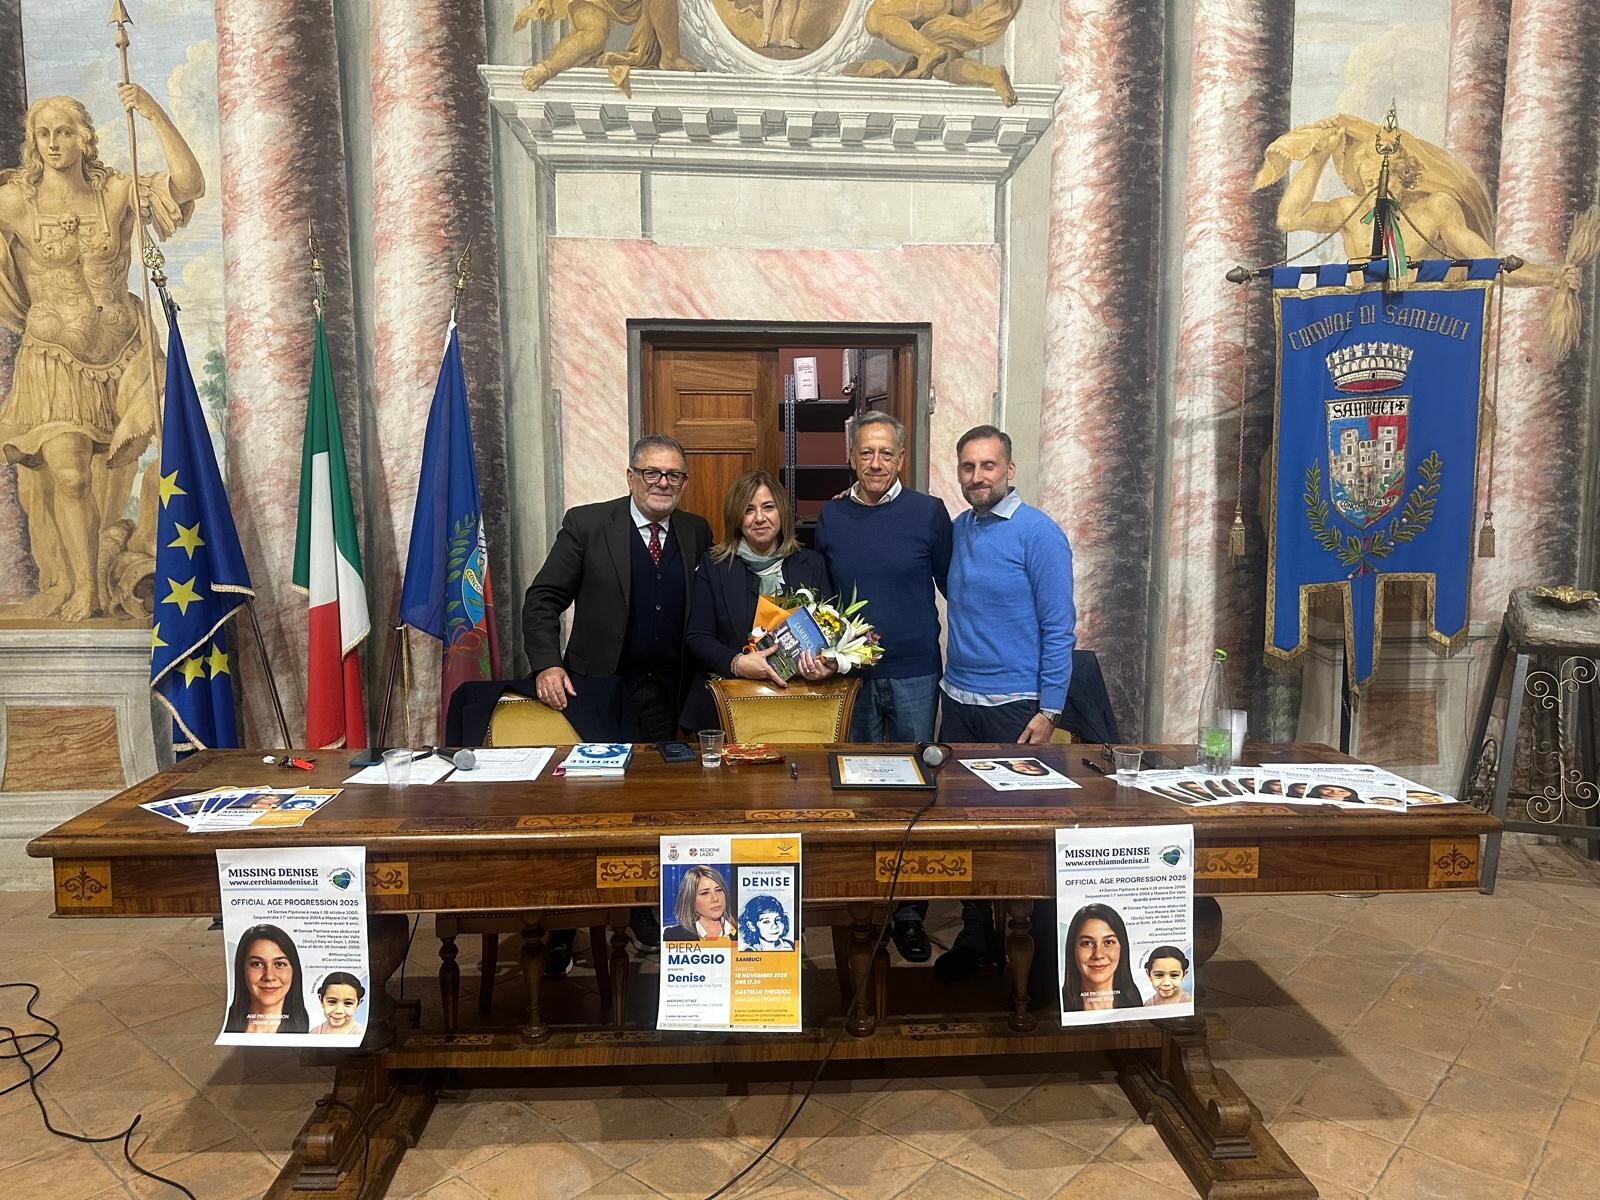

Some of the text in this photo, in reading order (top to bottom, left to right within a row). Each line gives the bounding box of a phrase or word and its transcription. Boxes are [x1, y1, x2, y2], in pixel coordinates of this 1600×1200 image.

[1288, 304, 1470, 351] COMUNE DI SAMBUCI
[1333, 400, 1394, 418] SAMBUCI
[793, 622, 814, 650] SAMBUCI
[1065, 847, 1150, 858] MISSING DENISE
[1065, 857, 1150, 866] www.cerchiamodenise.it
[228, 868, 318, 877] MISSING DENISE
[743, 877, 790, 886] DENISE
[1116, 876, 1167, 884] PROGRESSION
[668, 943, 701, 953] PIERA
[668, 954, 724, 964] MAGGIO
[668, 972, 705, 982] Denise
